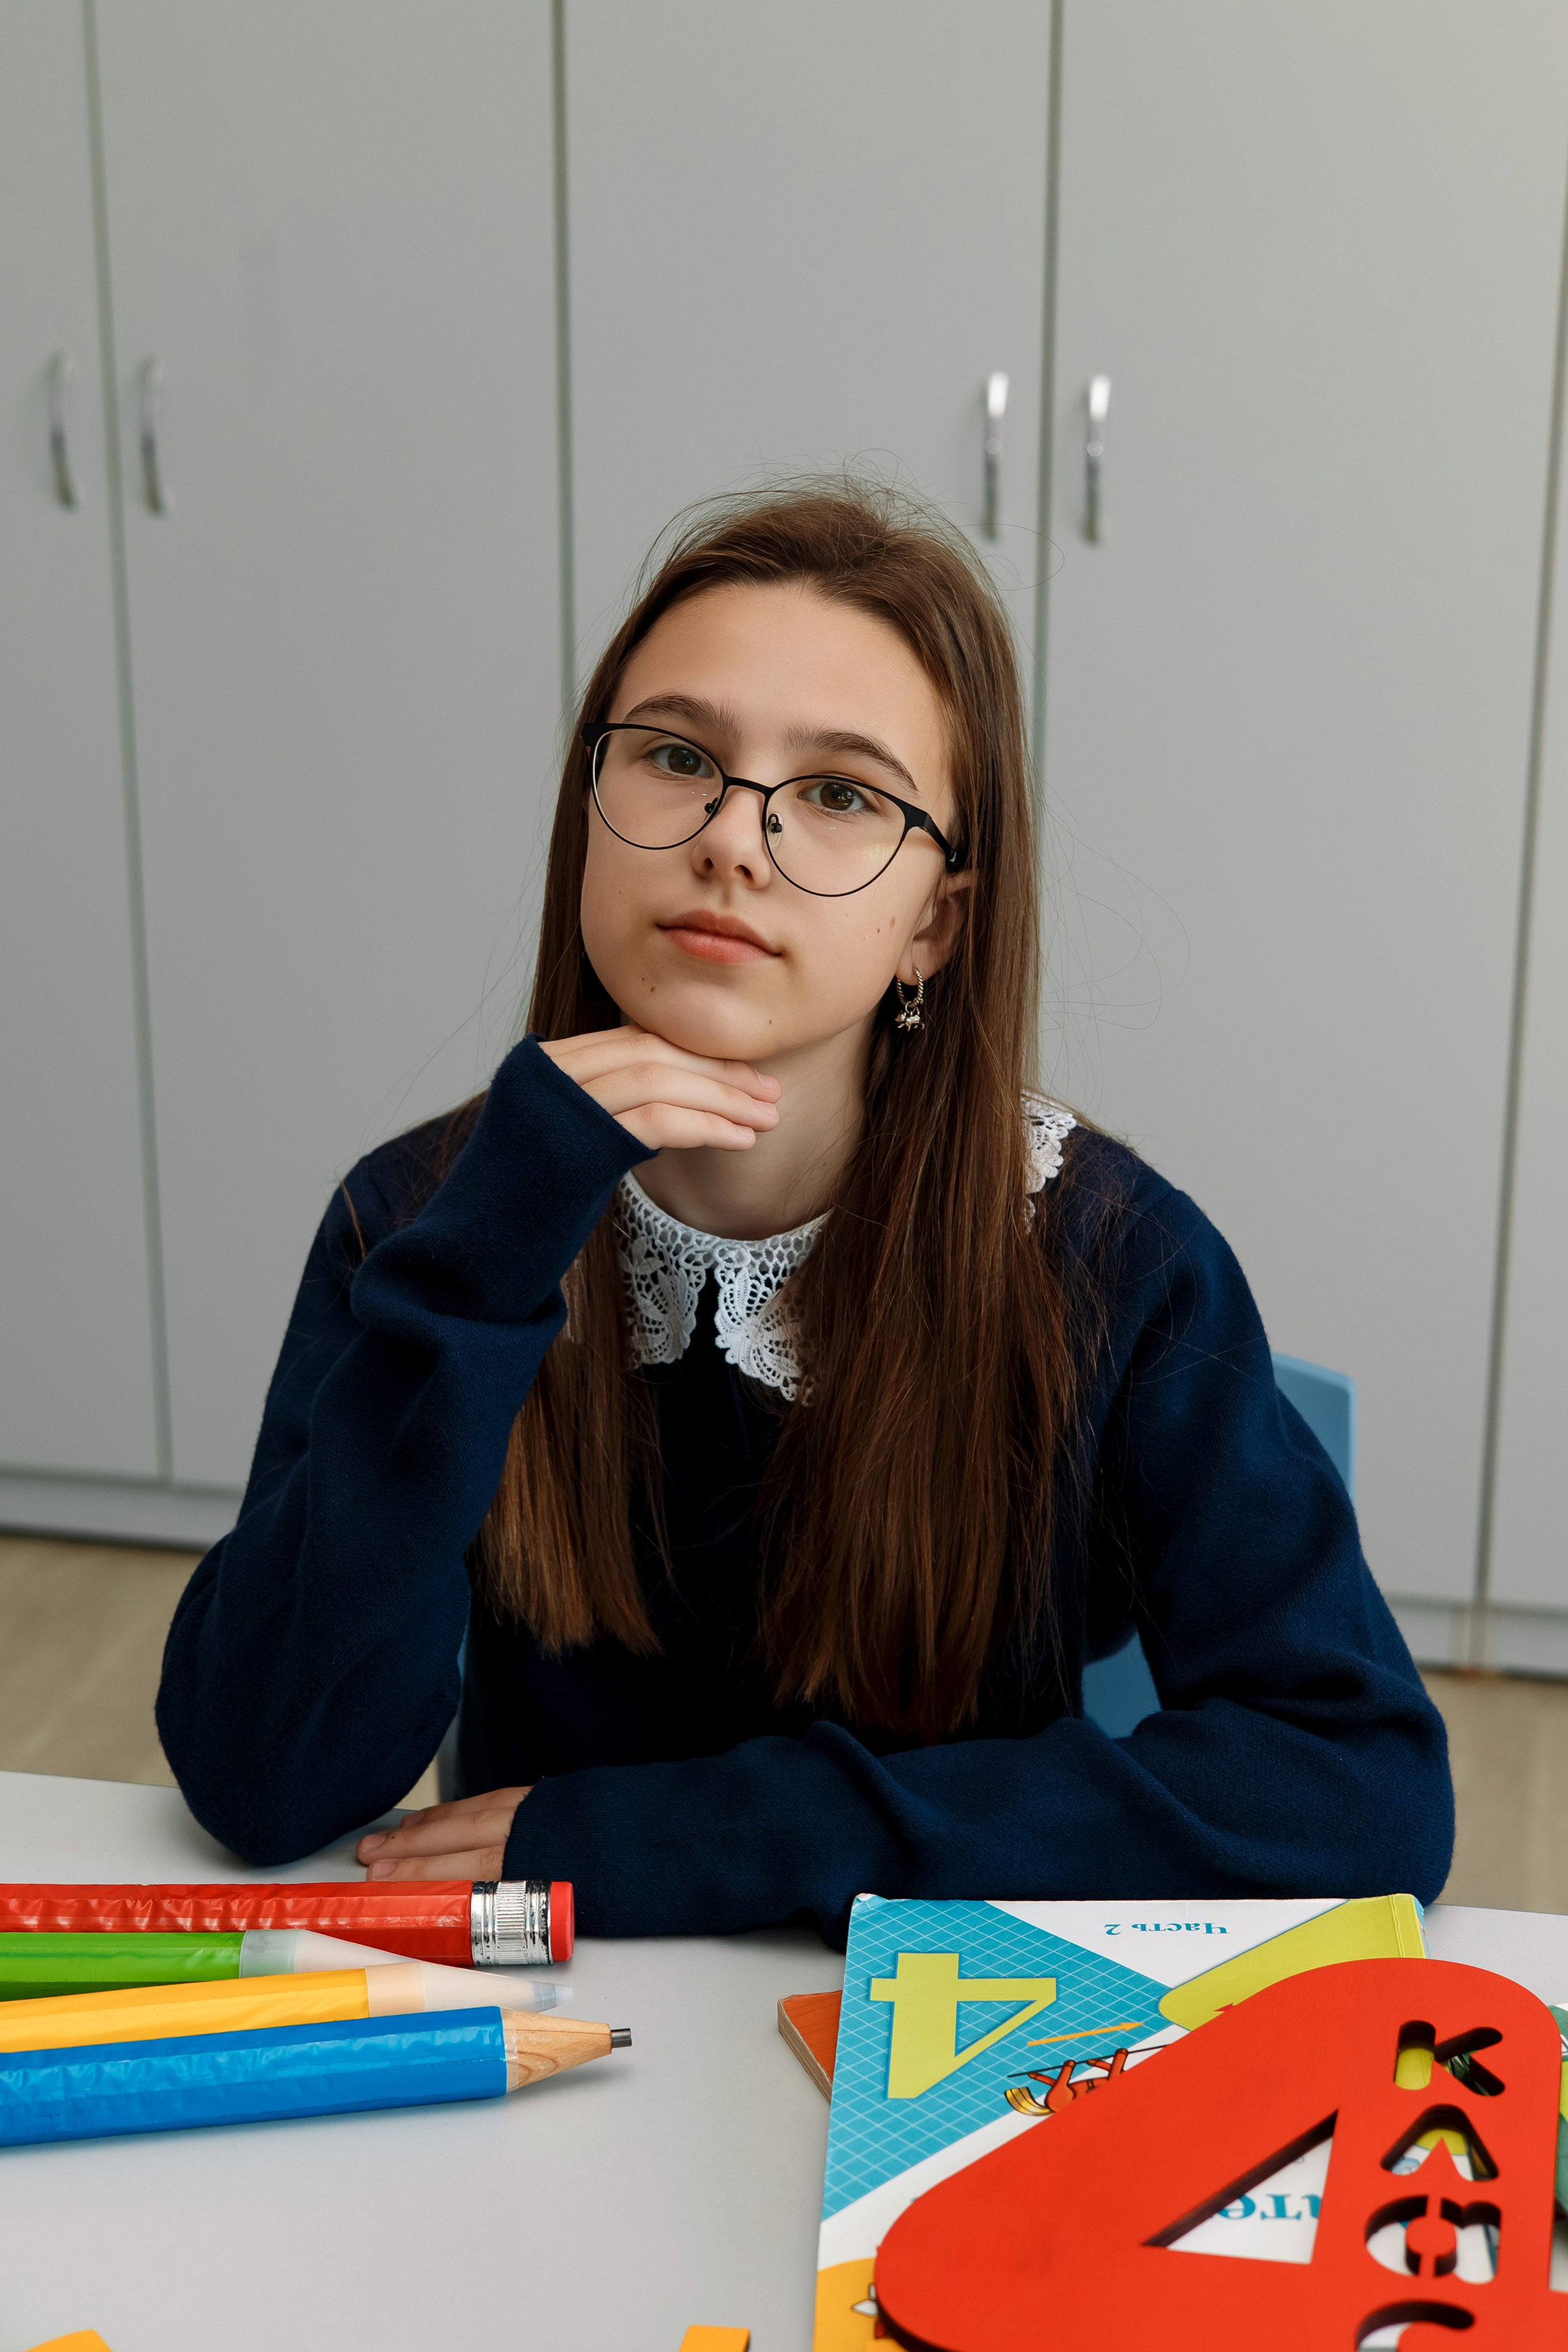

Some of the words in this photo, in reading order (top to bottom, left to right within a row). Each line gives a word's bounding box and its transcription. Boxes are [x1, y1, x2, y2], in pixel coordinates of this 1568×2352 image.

[1104, 1923, 1121, 1936] 2
[1131, 1922, 1229, 1934] Часть
[869, 1952, 1057, 2099] 4
